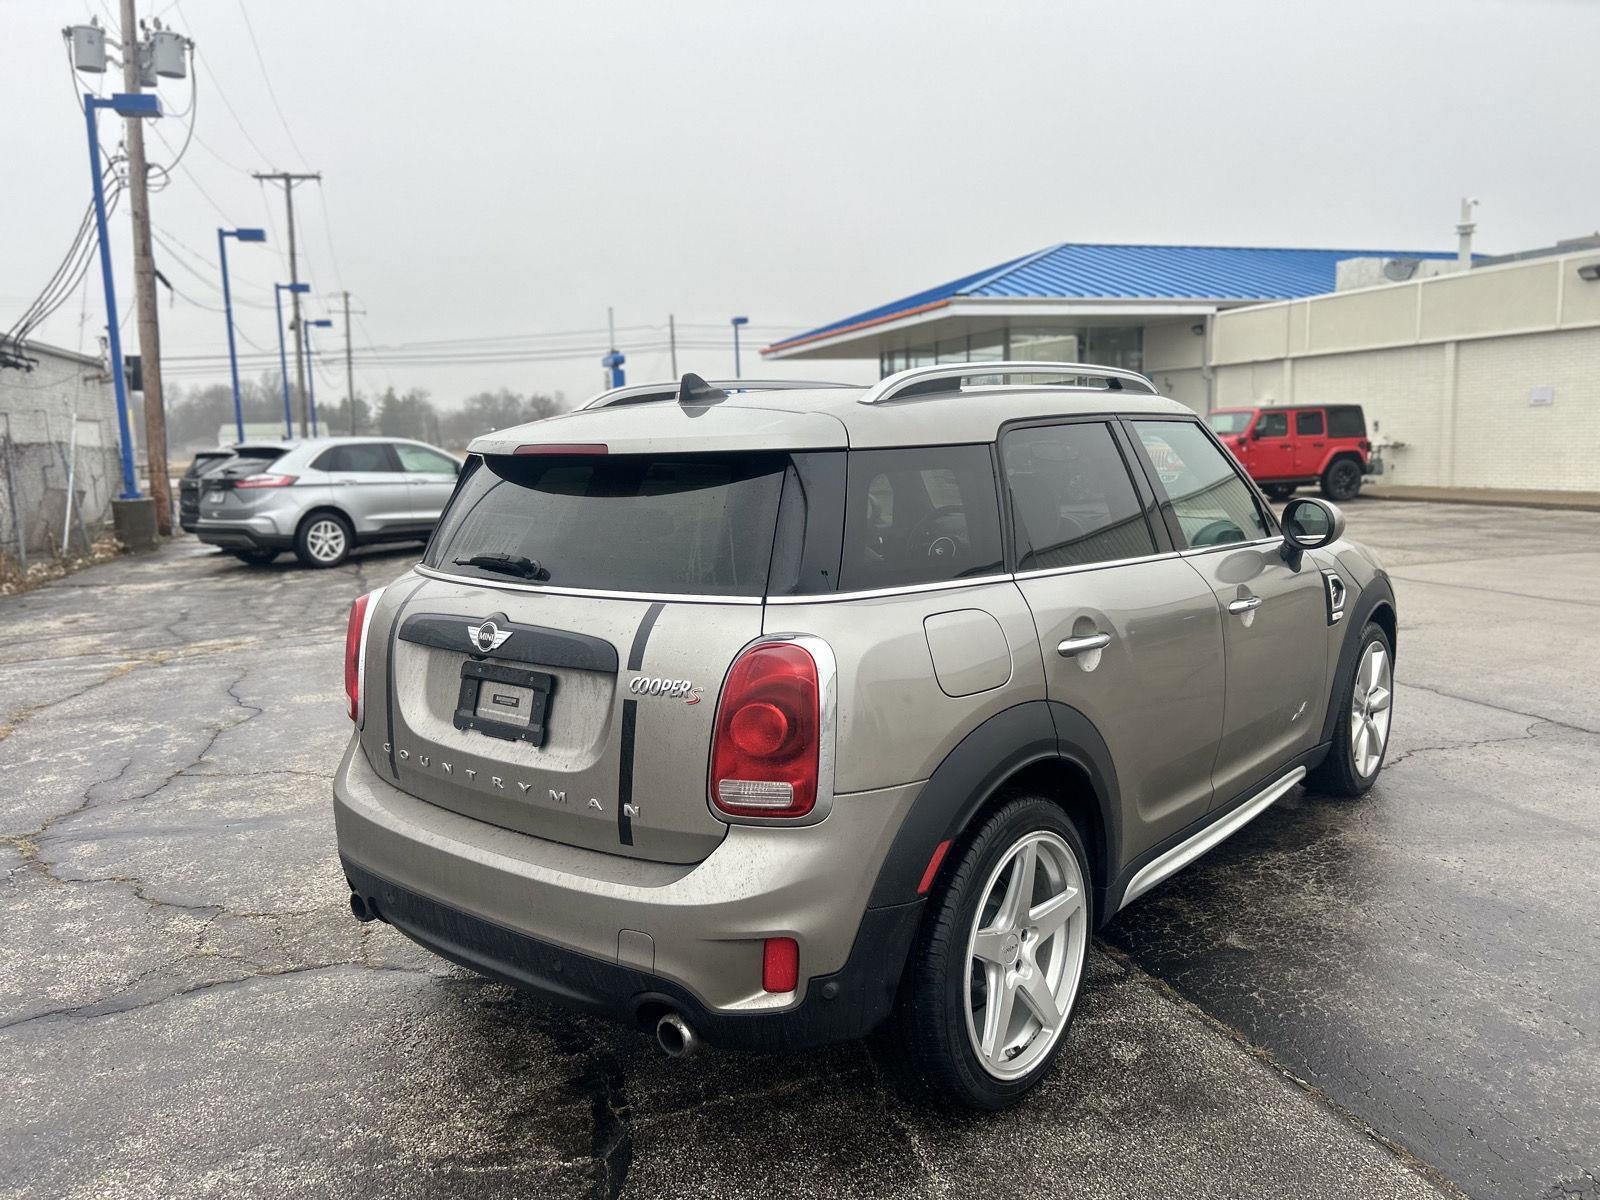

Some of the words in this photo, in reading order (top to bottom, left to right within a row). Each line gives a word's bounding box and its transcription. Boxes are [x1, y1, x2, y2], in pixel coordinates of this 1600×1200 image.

[479, 632, 495, 642] MINI
[629, 676, 692, 698] COOPER
[682, 687, 704, 705] S
[383, 742, 640, 818] COUNTRYMAN
